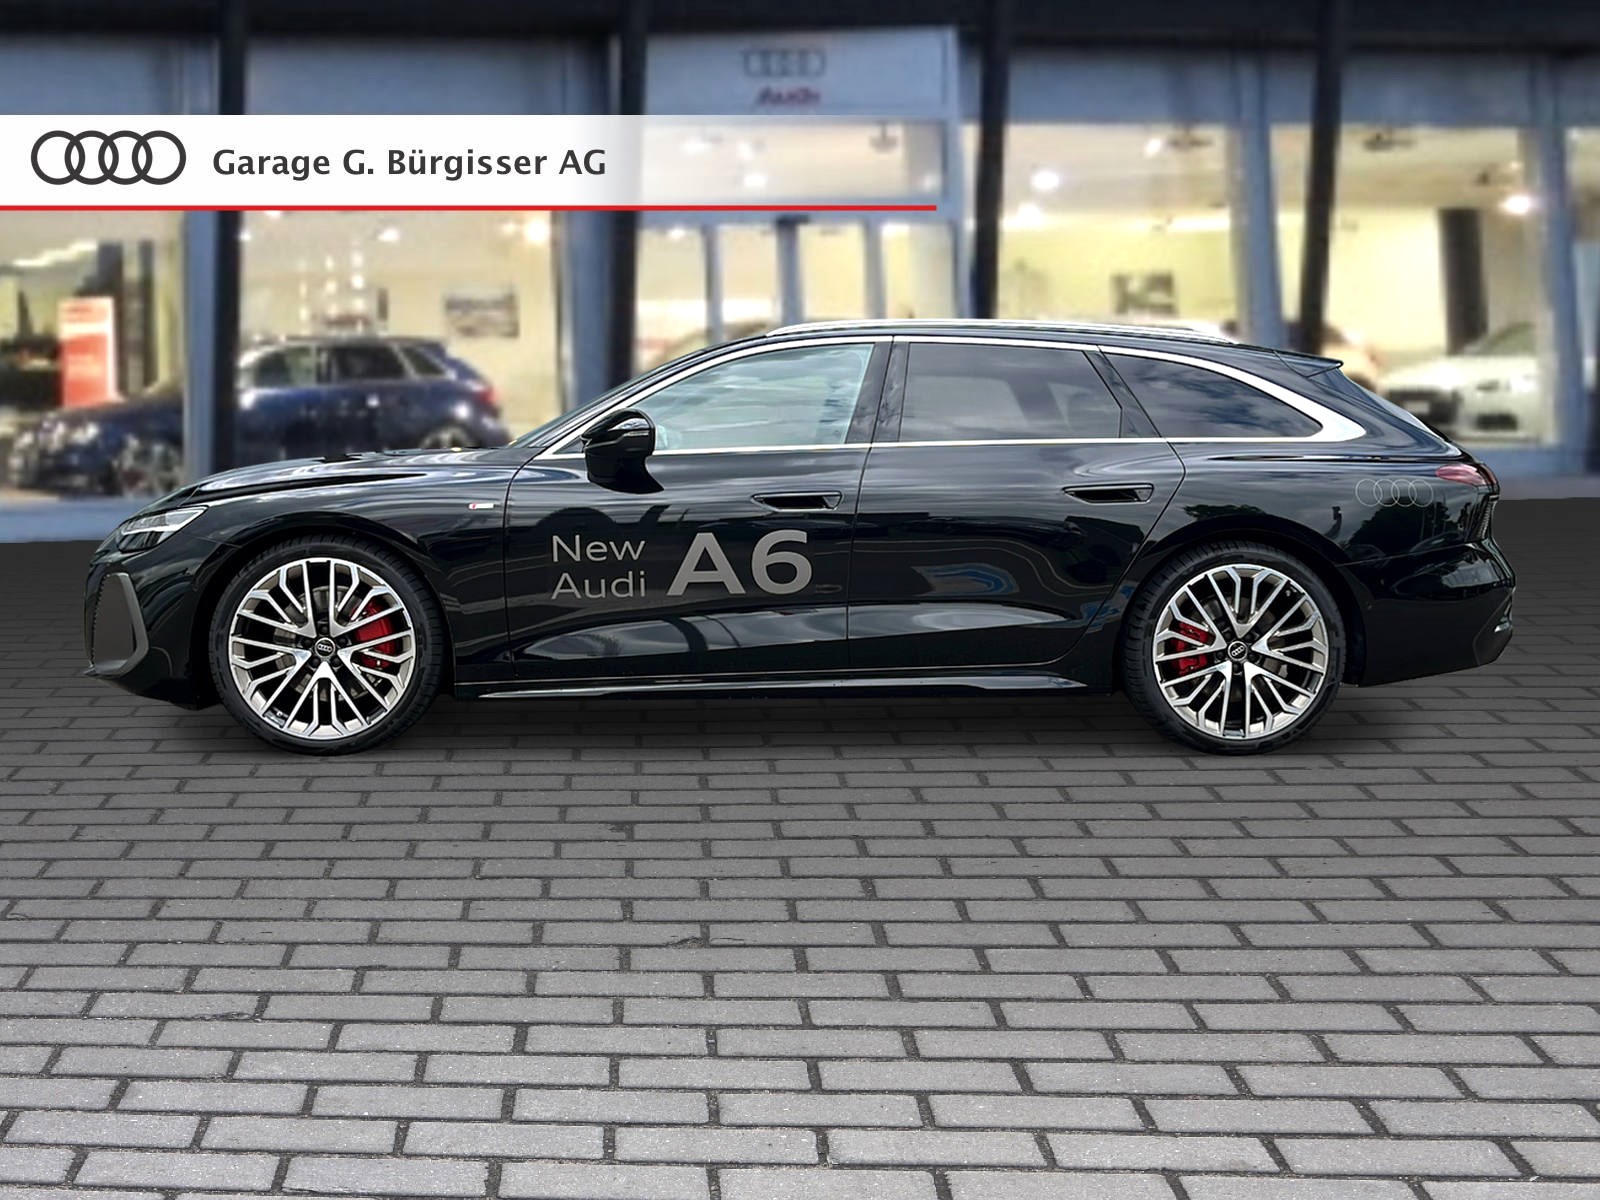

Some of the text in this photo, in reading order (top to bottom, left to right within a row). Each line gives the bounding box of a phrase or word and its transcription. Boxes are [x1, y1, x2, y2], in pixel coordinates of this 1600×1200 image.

[551, 534, 646, 563] New
[551, 529, 813, 600] Audi A6
